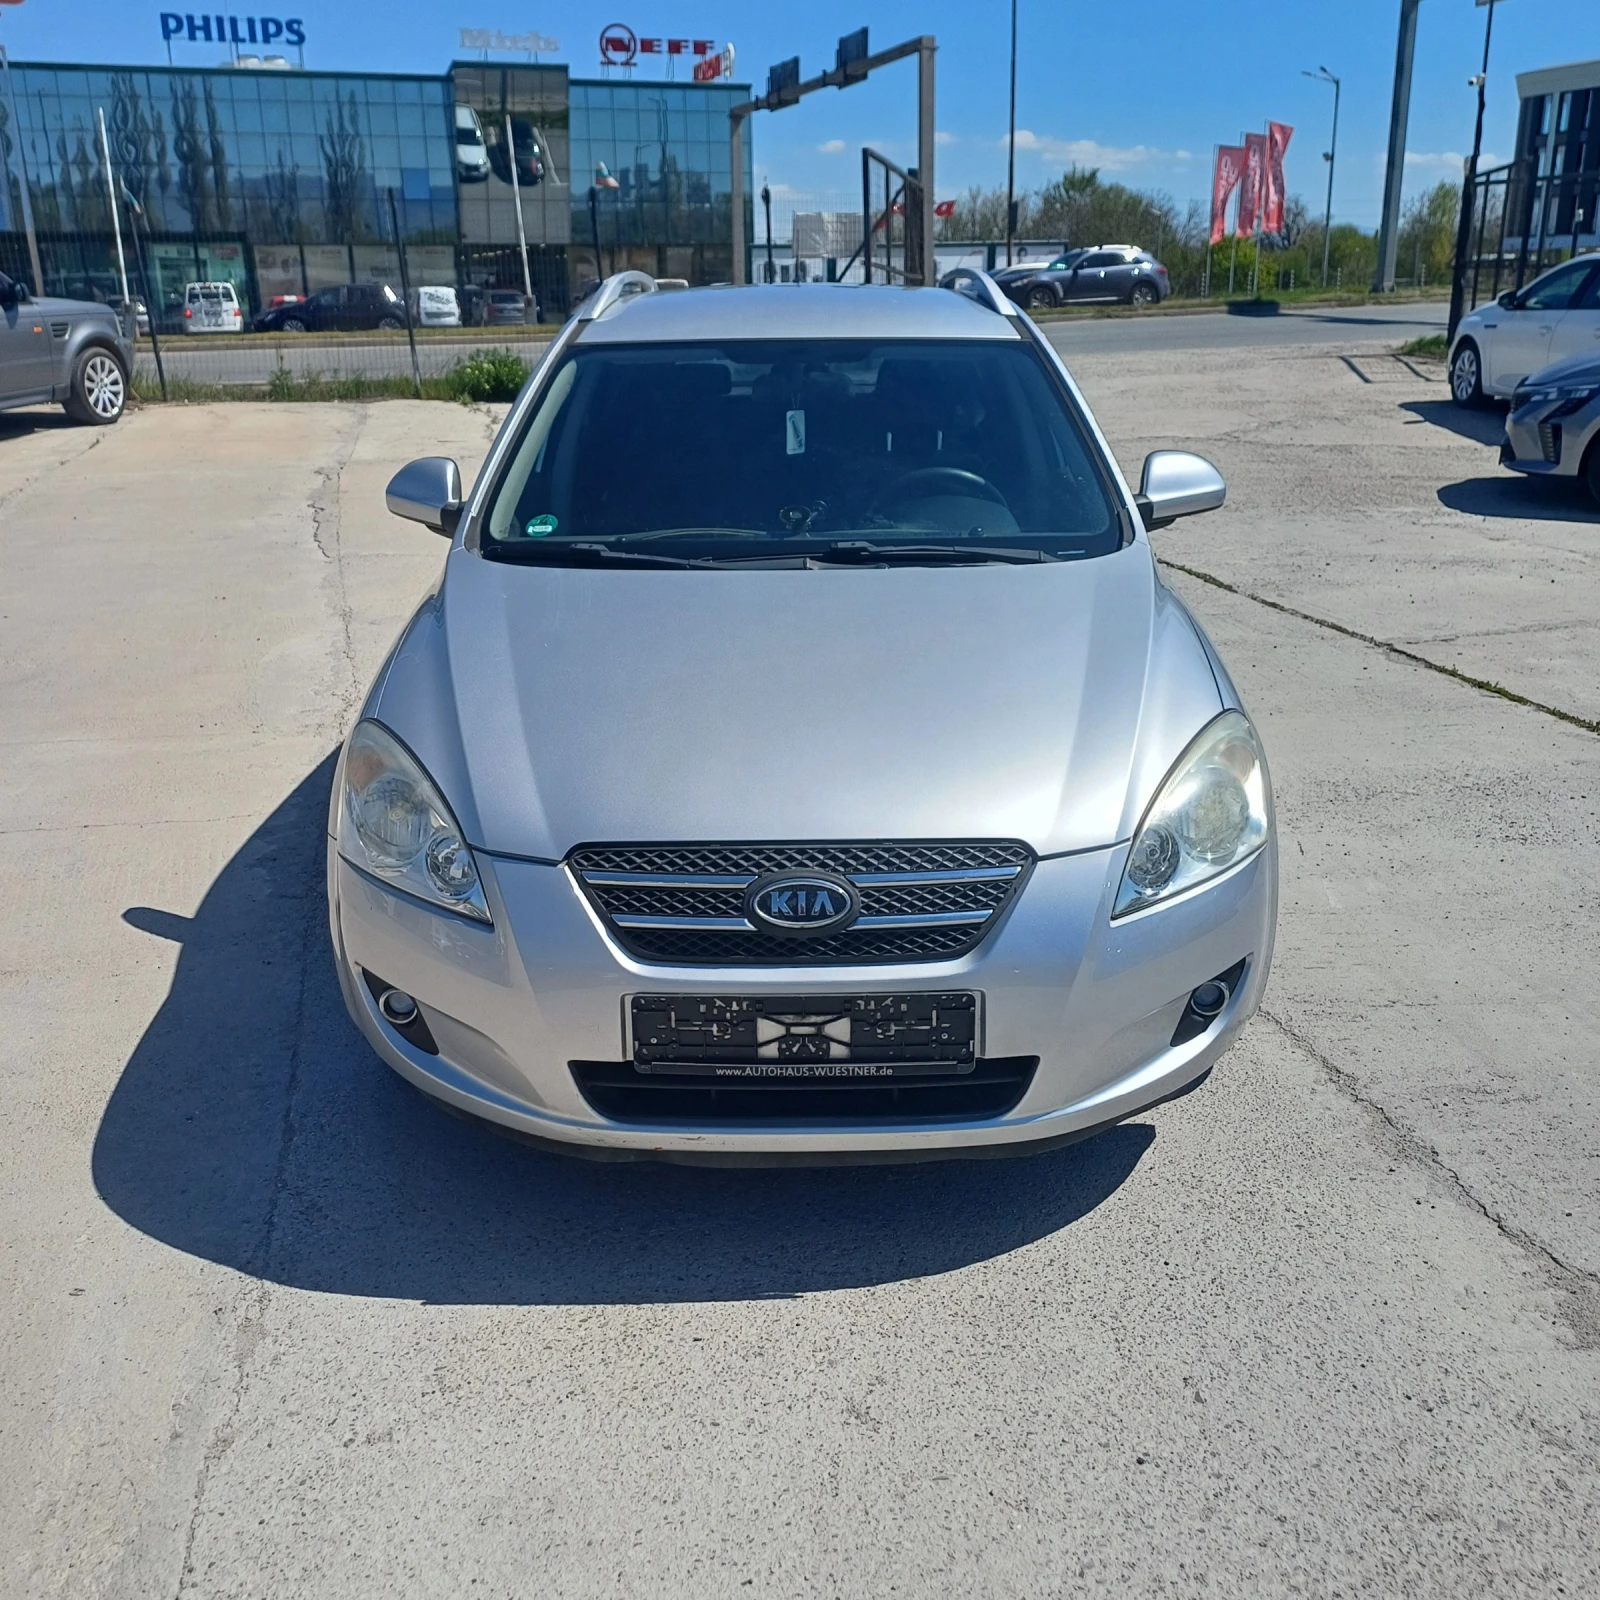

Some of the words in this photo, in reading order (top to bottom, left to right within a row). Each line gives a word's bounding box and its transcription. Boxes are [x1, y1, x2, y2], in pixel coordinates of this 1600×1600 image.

[160, 12, 306, 45] PHILIPS
[605, 37, 715, 54] NEFF
[769, 891, 835, 915] KIA
[715, 1066, 893, 1077] www.AUTOHAUS-WUESTNER.de
